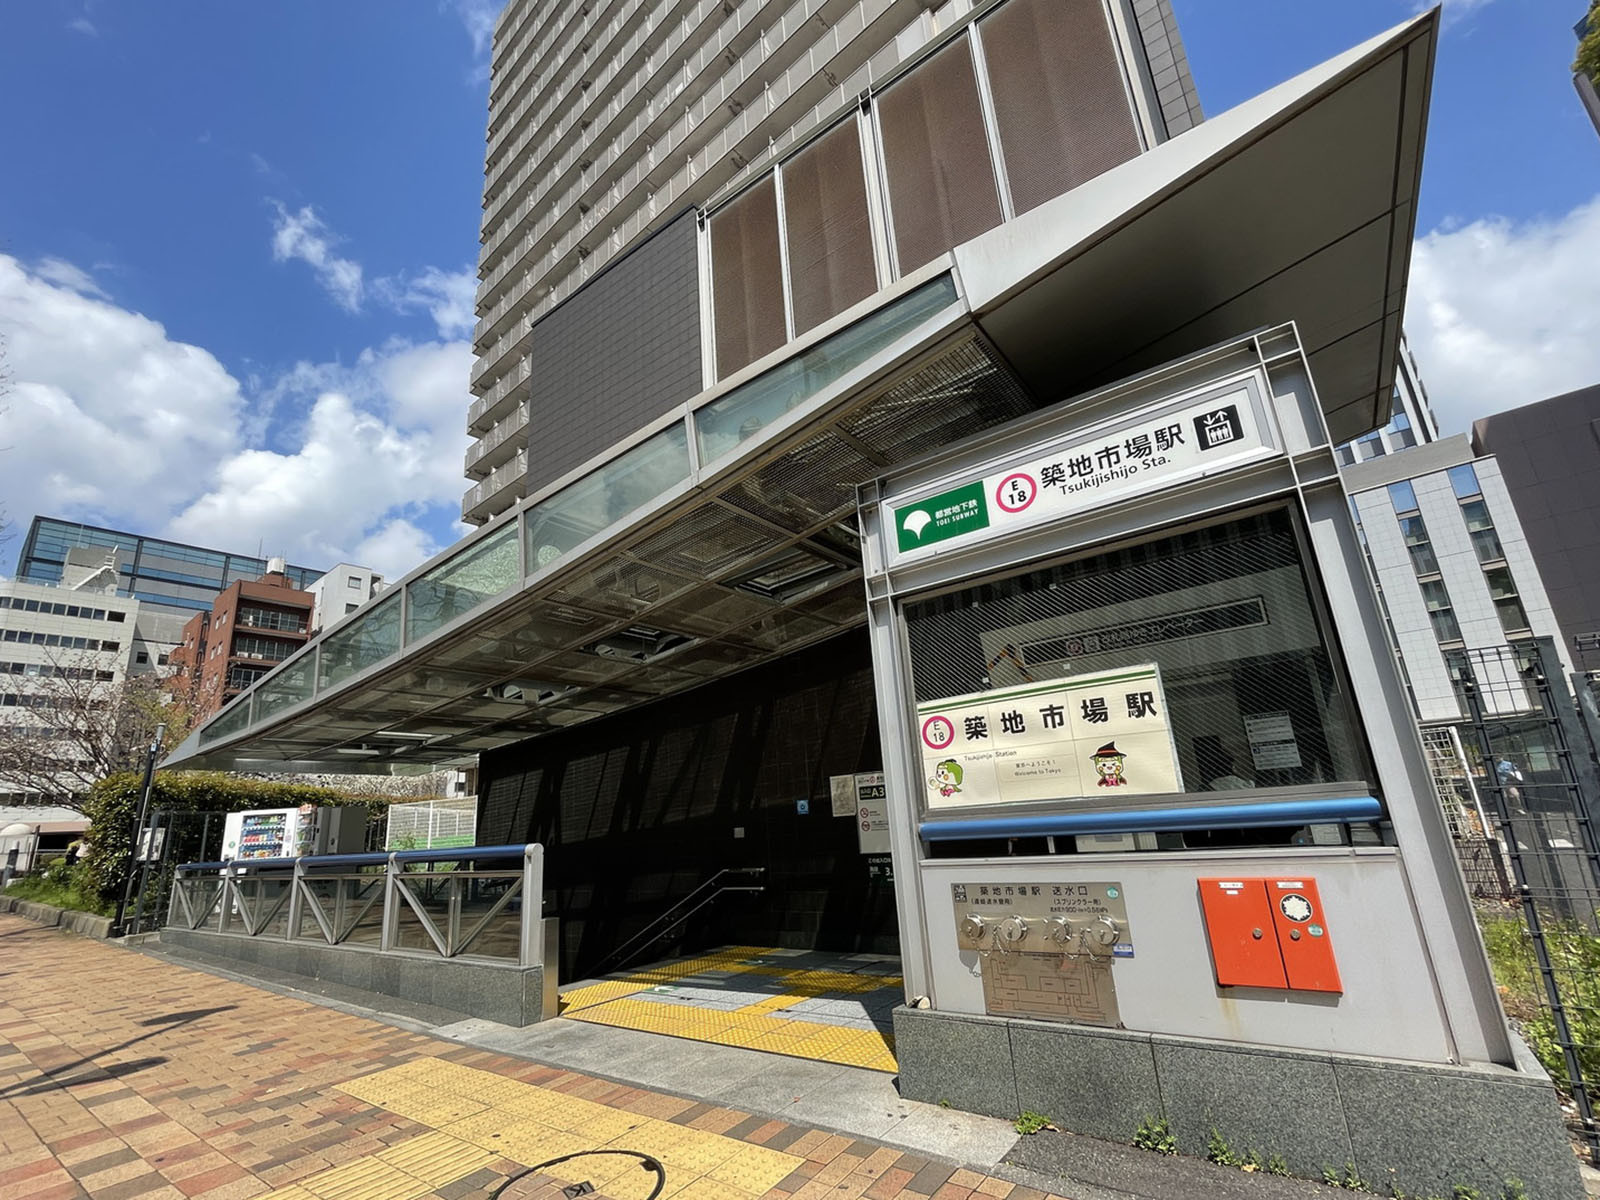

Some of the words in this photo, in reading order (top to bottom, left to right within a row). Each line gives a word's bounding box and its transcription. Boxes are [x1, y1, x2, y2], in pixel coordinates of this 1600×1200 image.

[1040, 422, 1185, 489] 築地市場駅
[1059, 463, 1138, 496] Tsukijishijo
[1142, 453, 1172, 473] Sta.
[1011, 479, 1019, 491] E
[1008, 490, 1027, 505] 18
[935, 499, 978, 519] 都営地下鉄
[936, 518, 951, 527] TOEI
[952, 508, 979, 522] SUBWAY
[963, 691, 1158, 741] 築地市場駅
[933, 720, 941, 731] E
[933, 732, 945, 742] 18
[871, 786, 885, 797] A3
[979, 886, 1041, 897] 築地市場駅
[1052, 886, 1089, 897] 送水口
